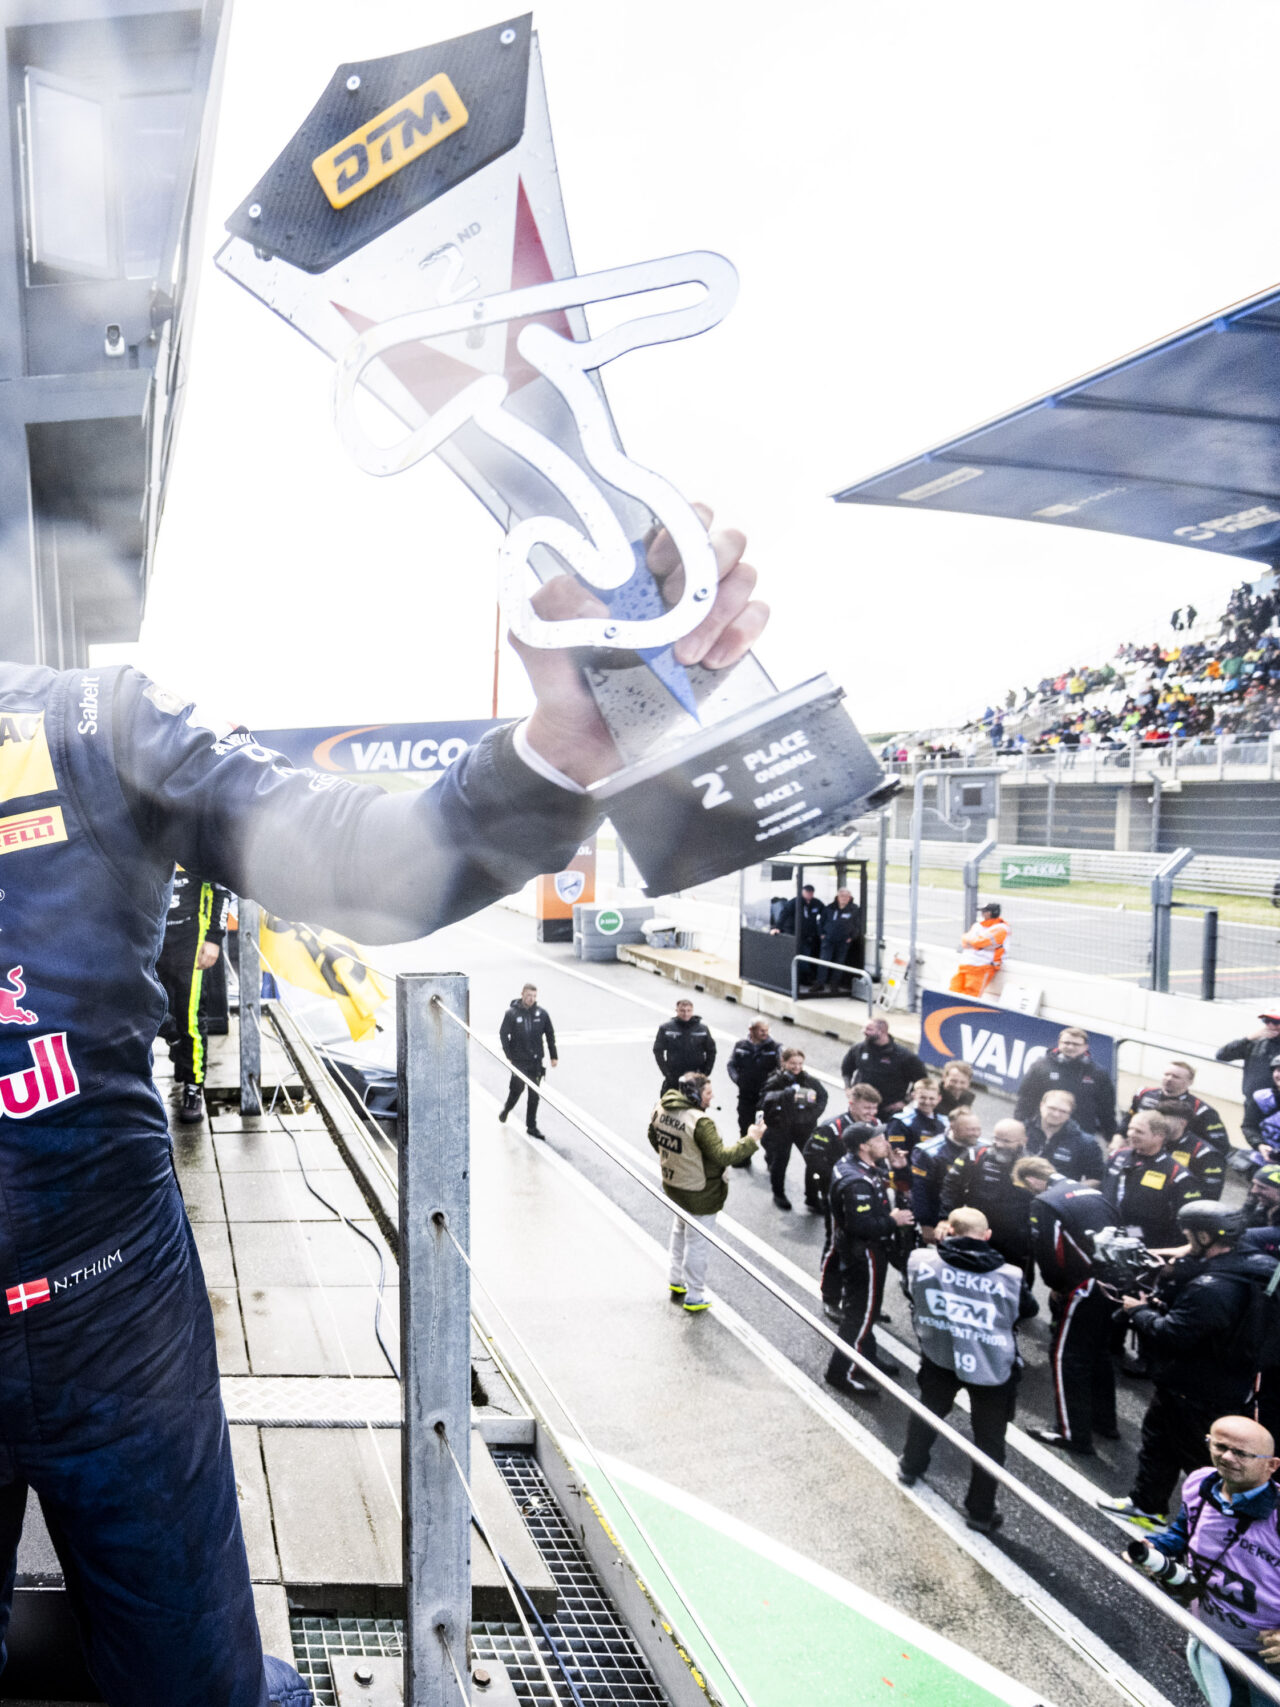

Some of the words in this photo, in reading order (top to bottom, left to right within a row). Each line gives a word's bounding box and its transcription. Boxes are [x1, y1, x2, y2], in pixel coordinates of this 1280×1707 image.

[333, 90, 452, 195] DTM
[78, 675, 101, 735] Sabelt
[351, 738, 468, 771] VAICO
[742, 730, 810, 771] PLACE
[691, 772, 733, 810] 2
[753, 782, 793, 810] RACE
[660, 1113, 686, 1132] DEKRA
[54, 1249, 123, 1294] N.THIIM
[941, 1268, 1007, 1298] DEKRA
[933, 1294, 988, 1325] DTM
